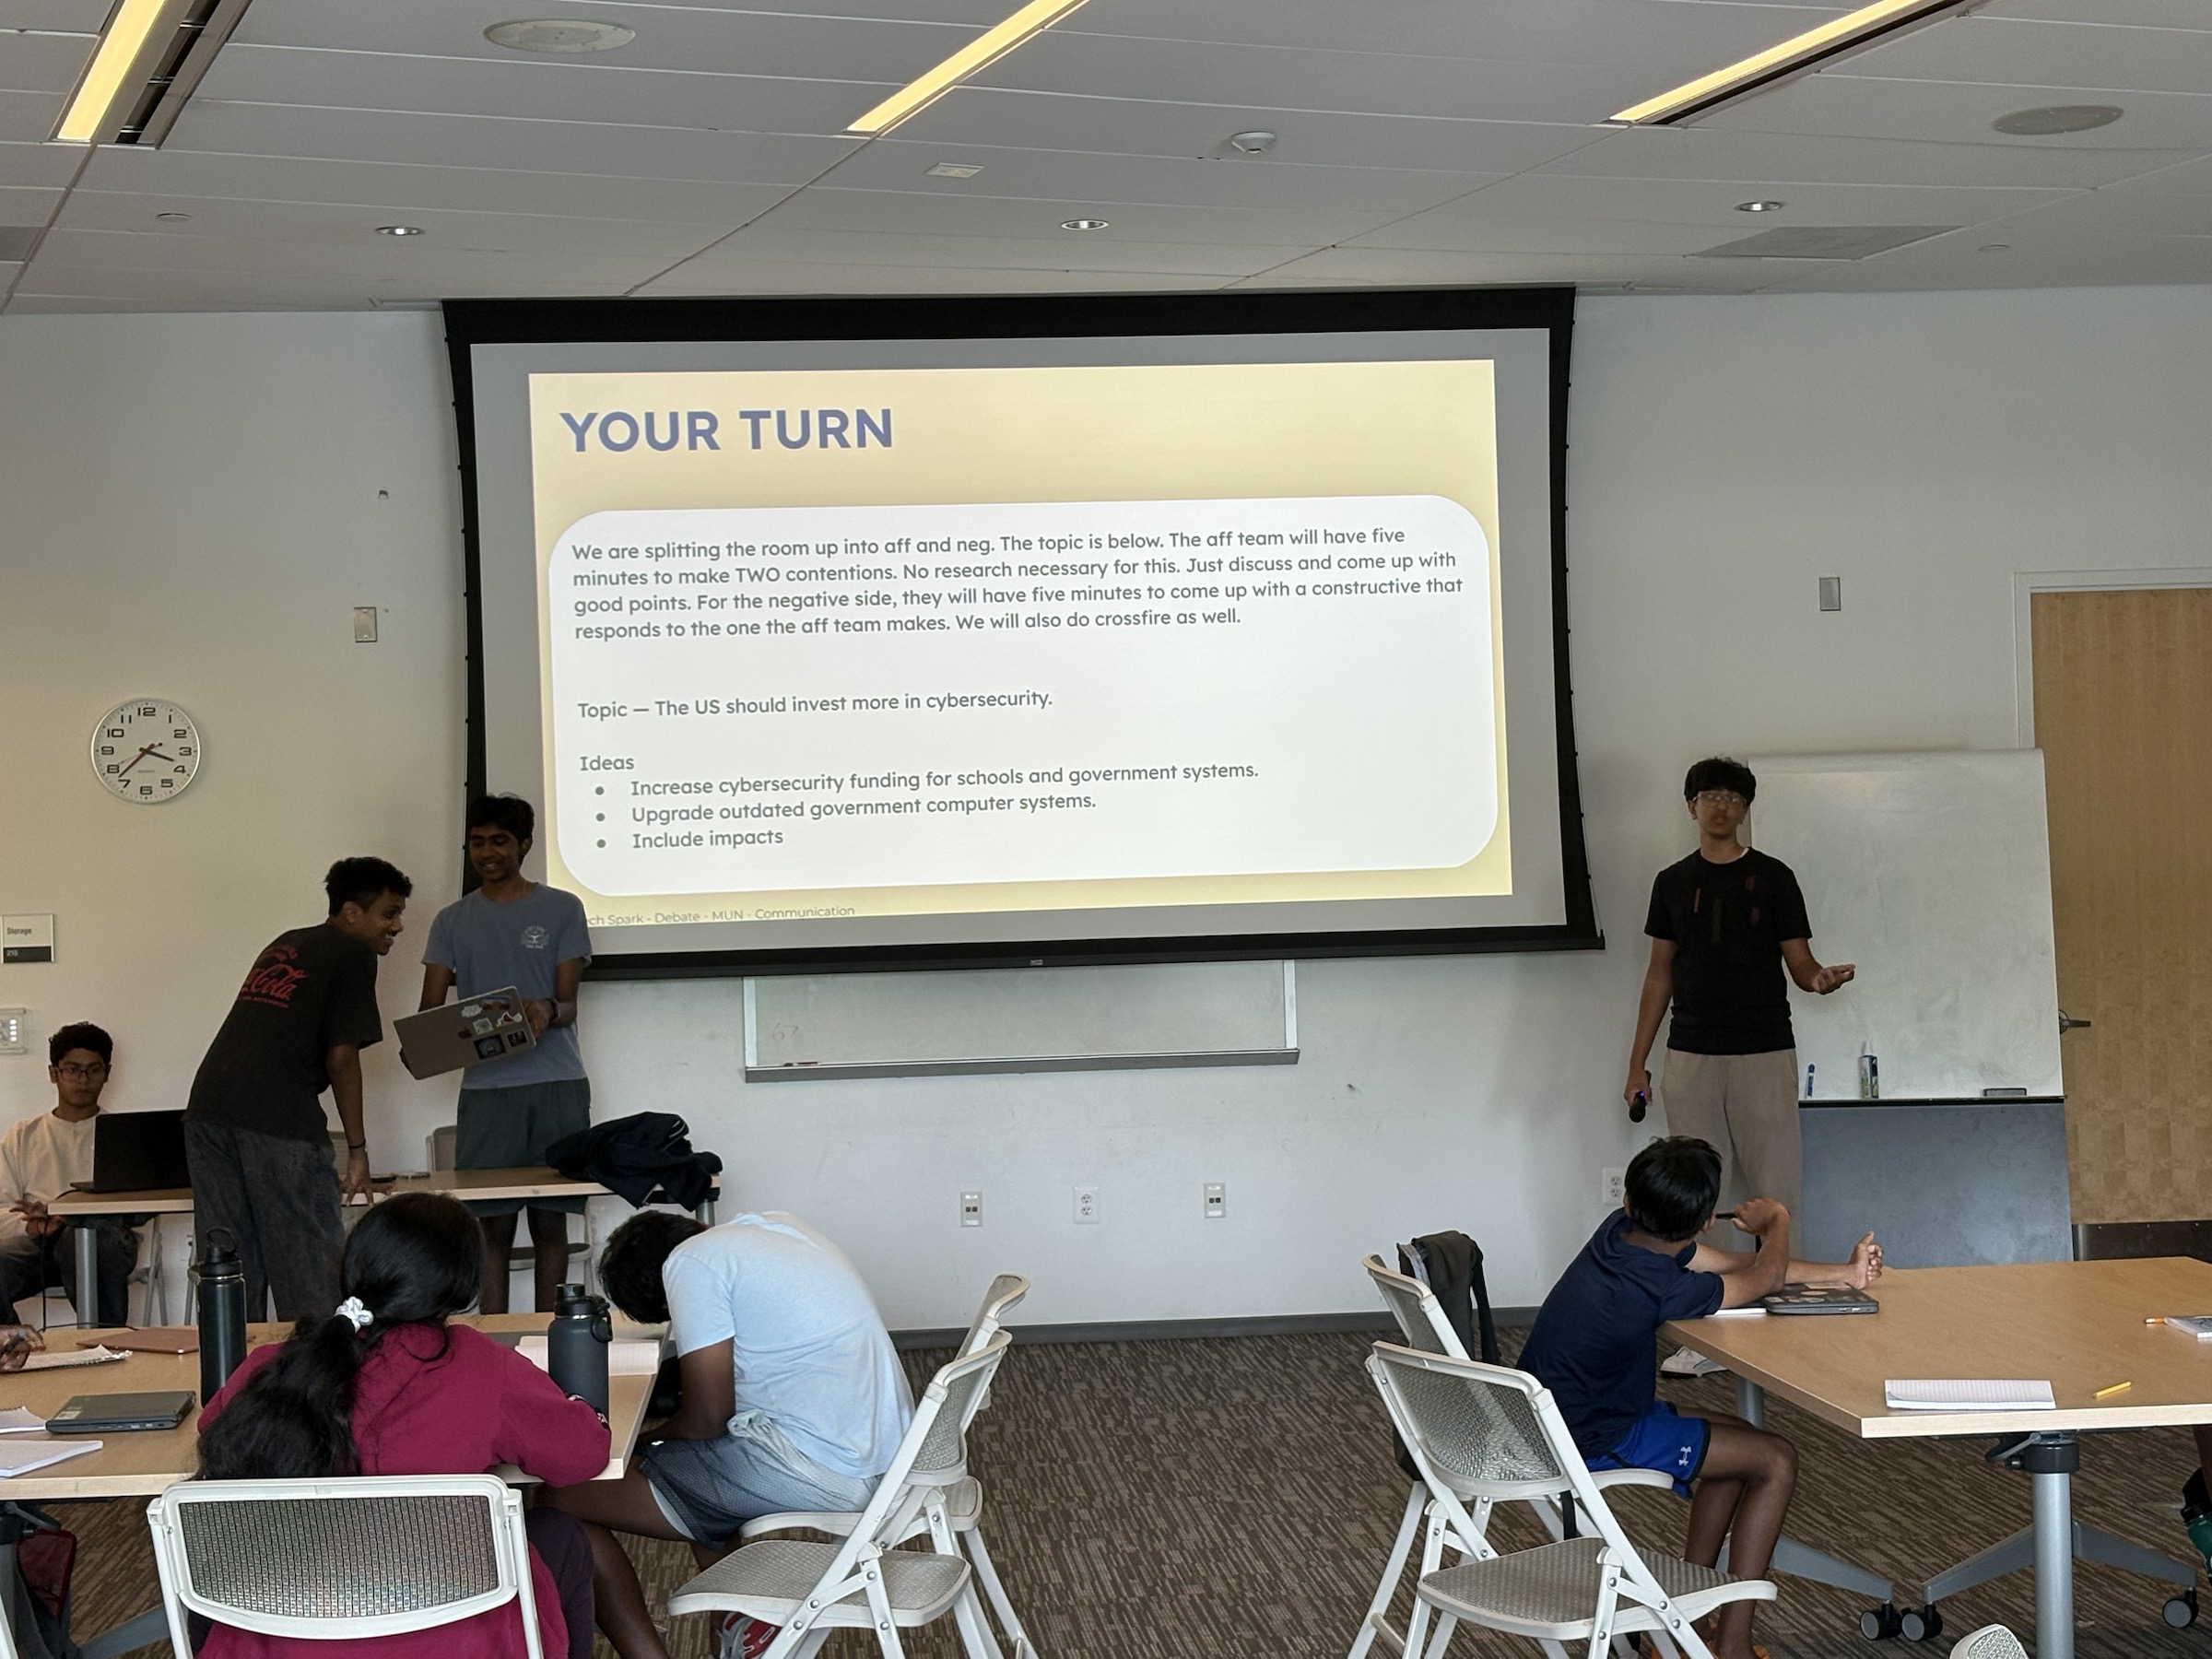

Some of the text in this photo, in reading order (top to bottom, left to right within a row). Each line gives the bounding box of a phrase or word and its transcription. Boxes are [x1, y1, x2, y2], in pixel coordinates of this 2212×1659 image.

[559, 407, 892, 453] YOUR TURN
[571, 526, 1406, 563] We are splitting the room up into aff and neg. The topic is below. The aff team will have five
[572, 550, 1456, 587] minutes to make TWO contentions. No research necessary for this. Just discuss and come up with
[573, 577, 1464, 618] good points. For the negative side, they will have five minutes to come up with a constructive that
[575, 606, 1241, 643] responds to the one the aff team makes. We will also do crossfire as well.
[137, 707, 156, 717] 12
[576, 700, 629, 723] Topic
[653, 700, 689, 717] The
[694, 699, 721, 715] US
[725, 696, 787, 714] should
[792, 695, 848, 712] invest
[852, 697, 900, 711] more
[904, 692, 921, 710] in
[925, 688, 1053, 712] cybersecurity.
[107, 728, 124, 738] 10
[173, 729, 187, 738] 2
[100, 746, 114, 756] 9
[179, 747, 192, 757] 3
[106, 764, 120, 774] 8
[173, 765, 186, 774] 4
[579, 754, 635, 771] Ideas
[118, 779, 131, 788] 7
[160, 779, 173, 788] 5
[630, 763, 1259, 797] Increase cybersecurity funding for schools and government systems.
[139, 785, 153, 795] 6
[631, 794, 1097, 827] Upgrade outdated government computer systems.
[632, 829, 784, 850] Include impacts
[587, 914, 605, 926] ch
[607, 912, 644, 927] Spark
[654, 911, 700, 923] Debate
[712, 910, 744, 921] MUN
[754, 906, 855, 920] Communication
